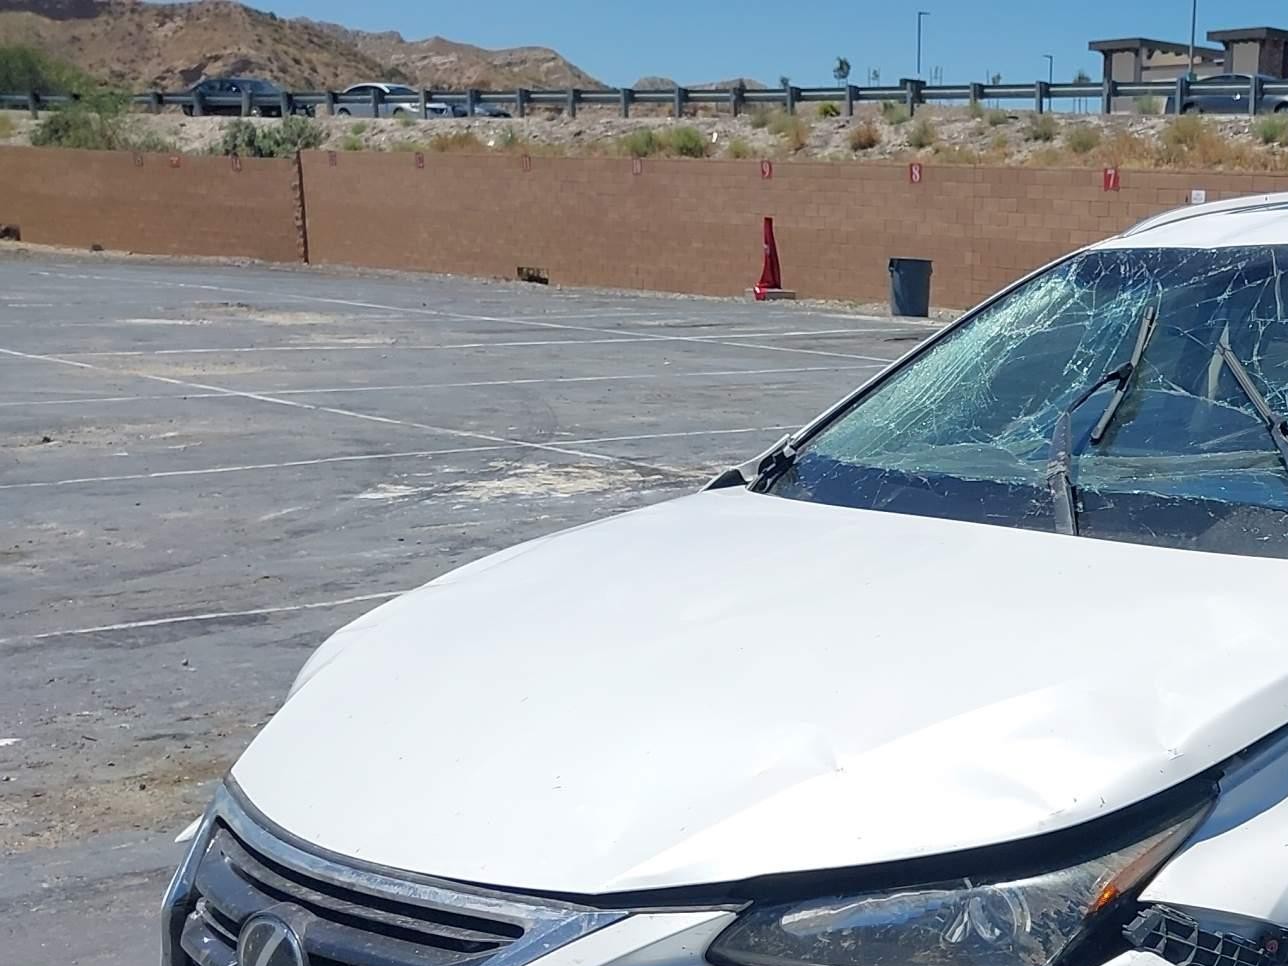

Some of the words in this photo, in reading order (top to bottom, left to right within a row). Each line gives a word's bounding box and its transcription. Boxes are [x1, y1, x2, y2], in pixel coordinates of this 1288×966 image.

[762, 161, 770, 177] 9
[911, 165, 920, 183] 8
[1106, 169, 1115, 189] 7
